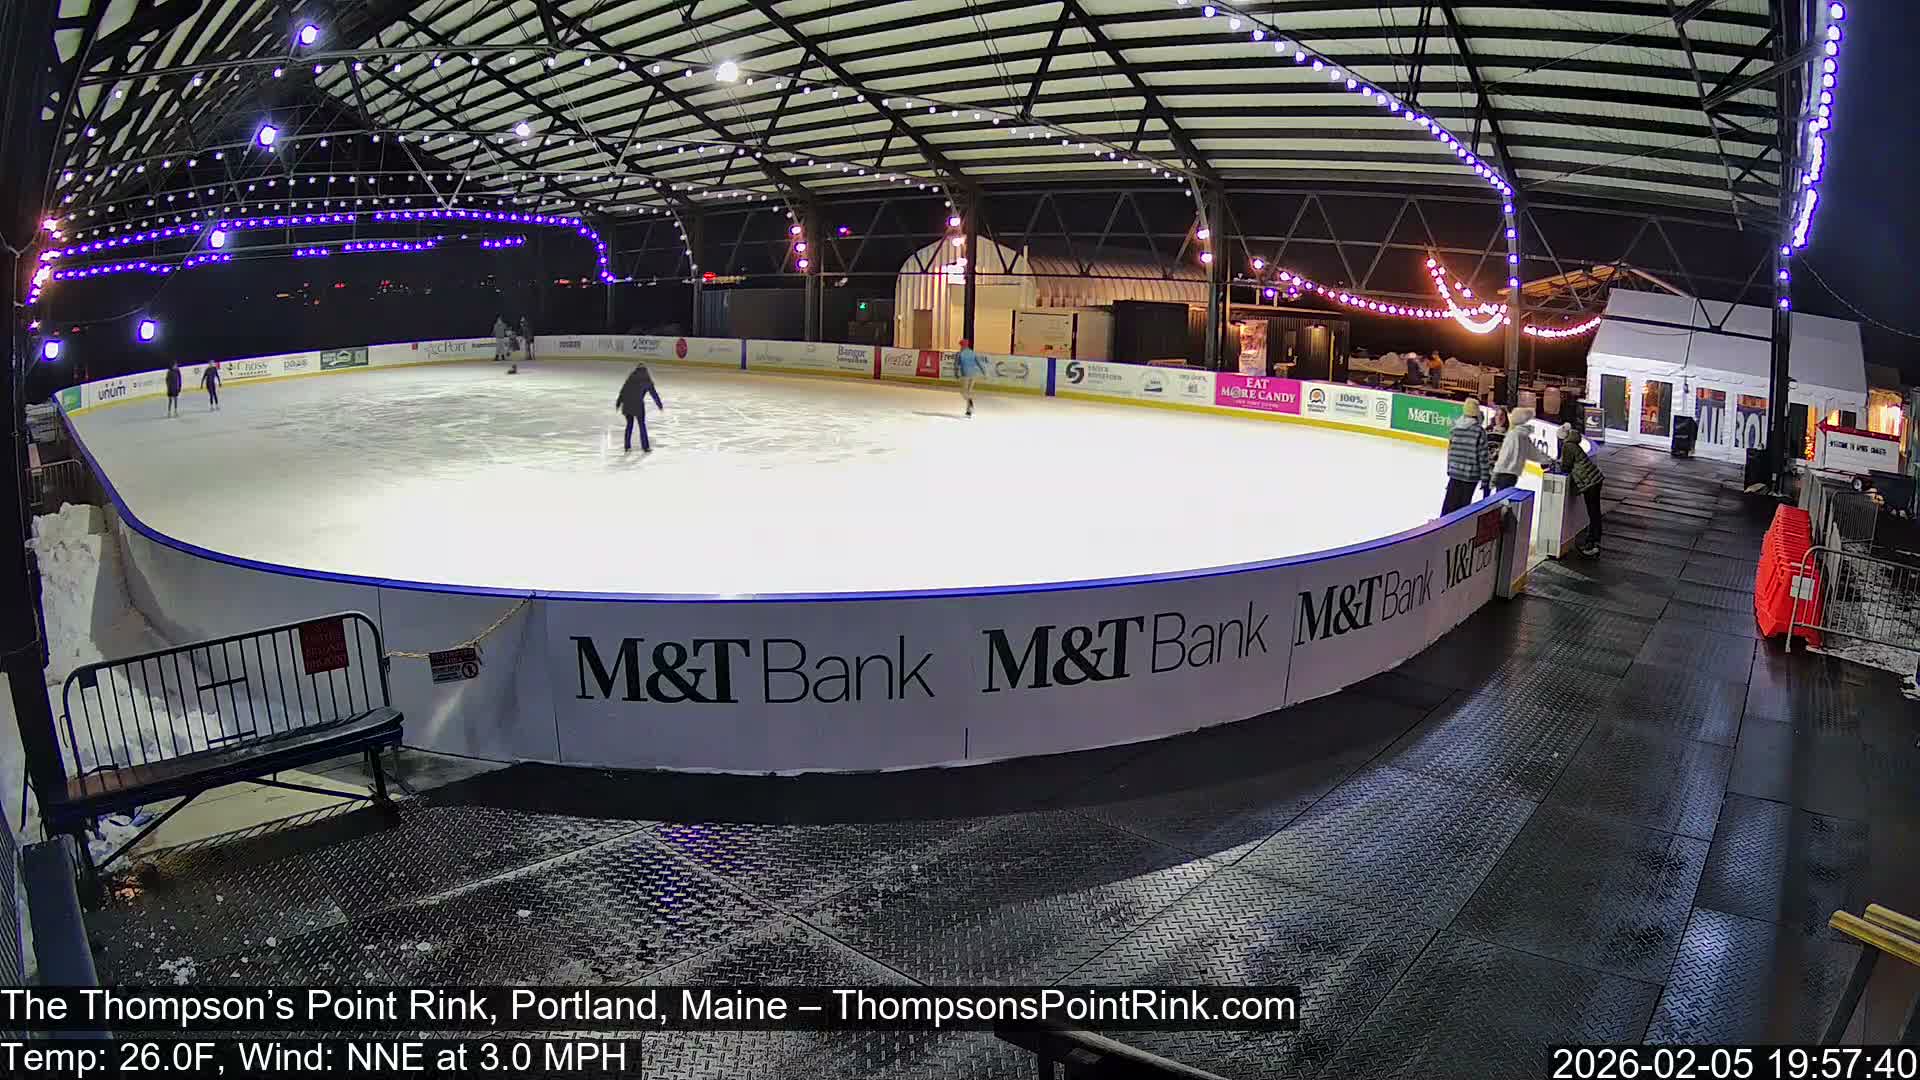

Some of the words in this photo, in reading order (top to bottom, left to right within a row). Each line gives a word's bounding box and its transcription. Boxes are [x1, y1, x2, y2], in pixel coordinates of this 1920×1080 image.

[1246, 377, 1270, 390] EAT
[1221, 385, 1256, 399] MORE
[1258, 391, 1296, 403] CANDY
[1339, 393, 1364, 404] 100%
[1408, 407, 1432, 423] M&T
[1295, 574, 1383, 647] M&T
[1382, 560, 1434, 621] Bank
[981, 615, 1145, 693] M&T
[1151, 600, 1269, 674] Bank
[569, 636, 751, 704] M&T
[762, 635, 936, 704] Bank
